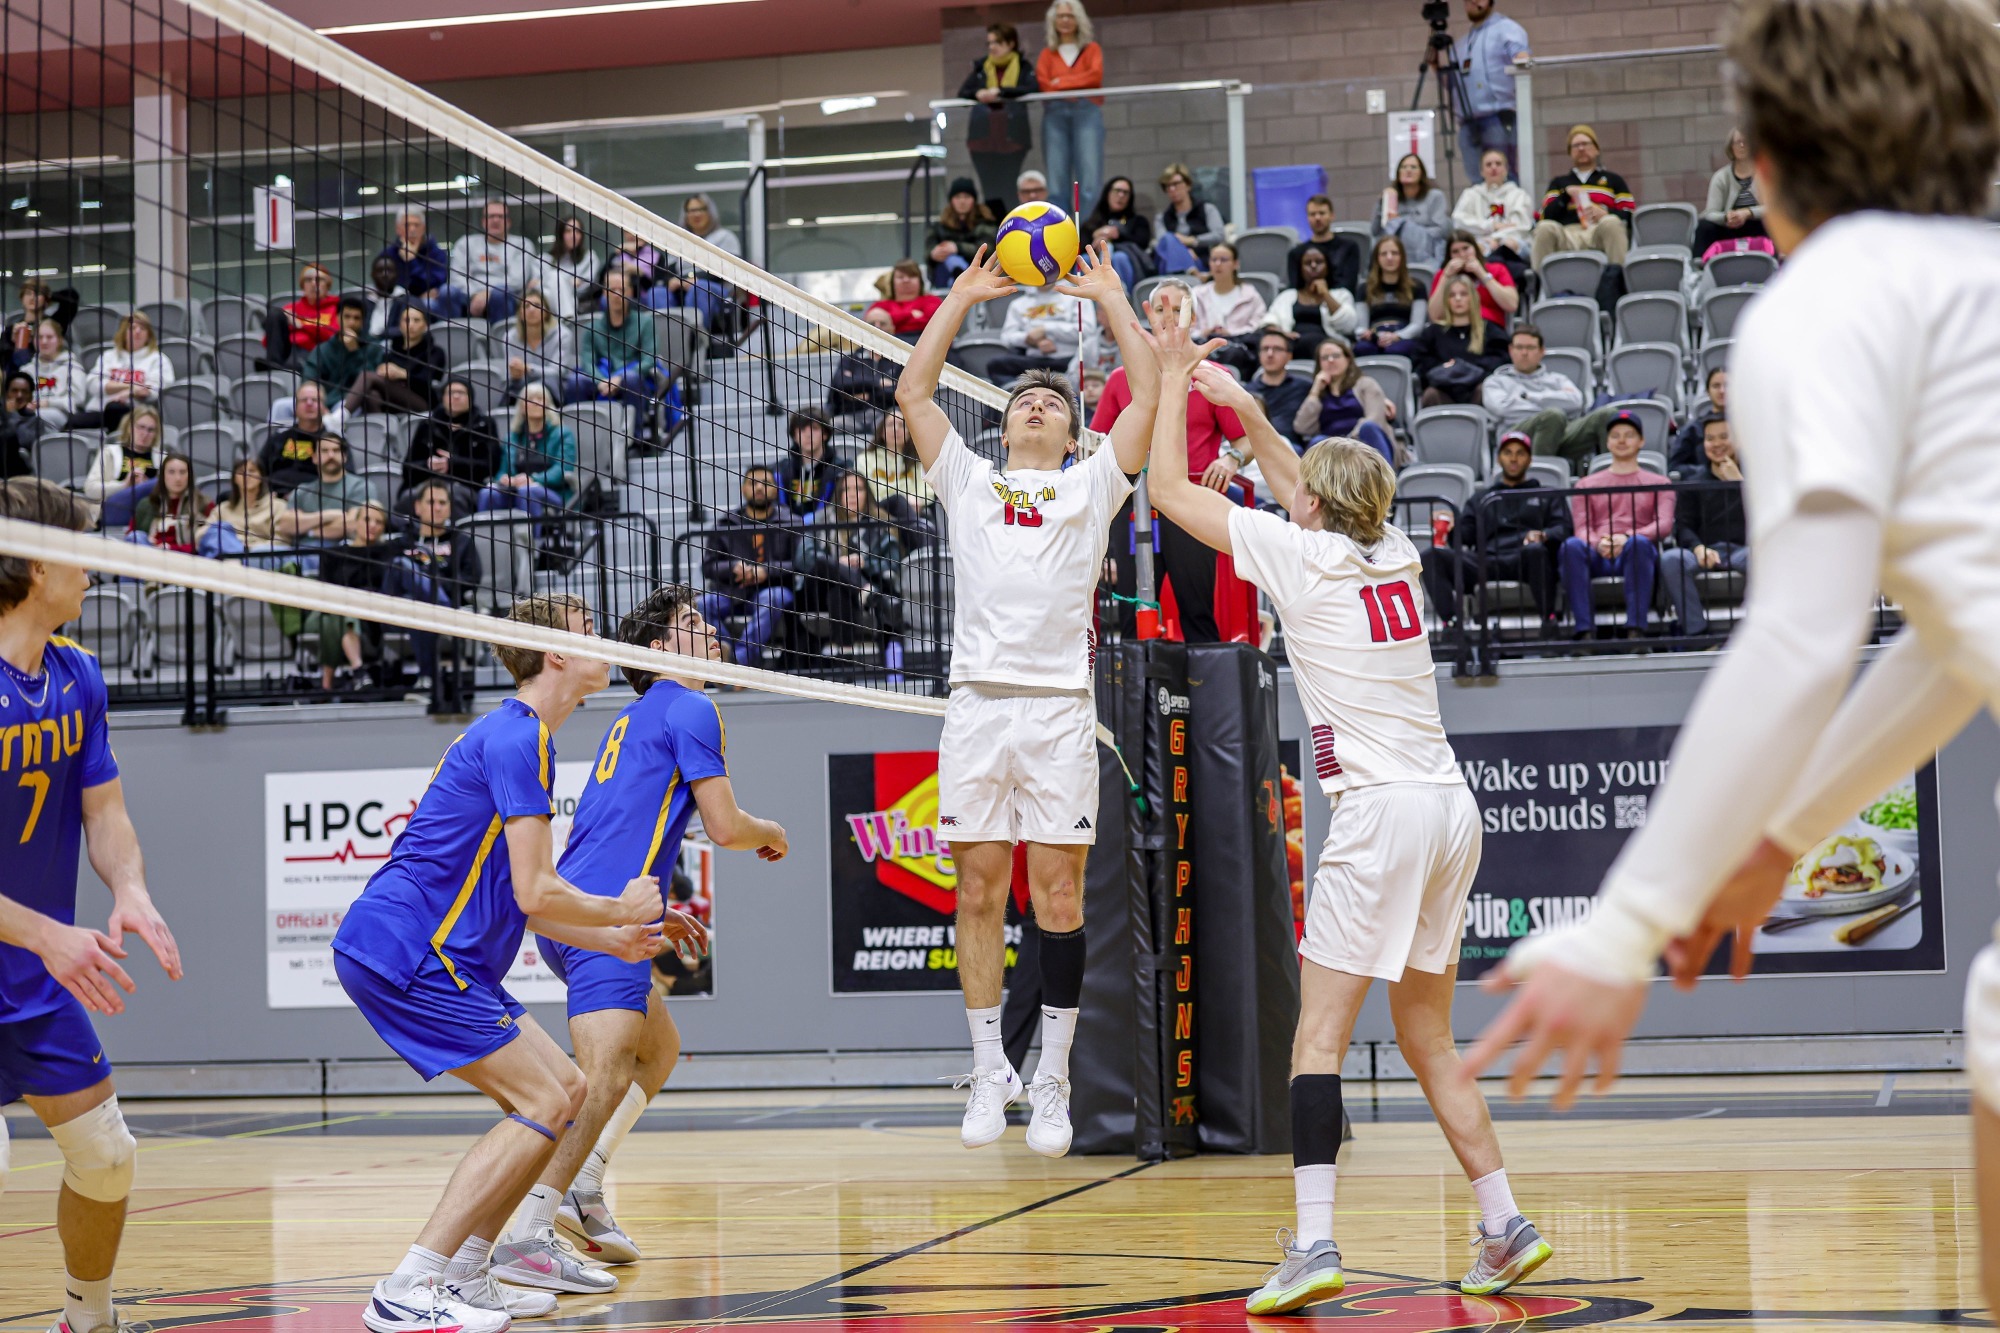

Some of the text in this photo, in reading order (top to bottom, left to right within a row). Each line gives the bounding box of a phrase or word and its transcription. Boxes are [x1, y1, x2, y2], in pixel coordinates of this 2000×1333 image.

[1359, 580, 1422, 642] 10
[595, 714, 630, 785] 8
[1459, 757, 1539, 793] Wake
[1547, 762, 1590, 796] up
[18, 770, 51, 845] 7
[284, 801, 384, 842] HPC
[1483, 797, 1607, 834] stebuds
[863, 926, 945, 948] WHERE
[853, 950, 926, 971] REIGN
